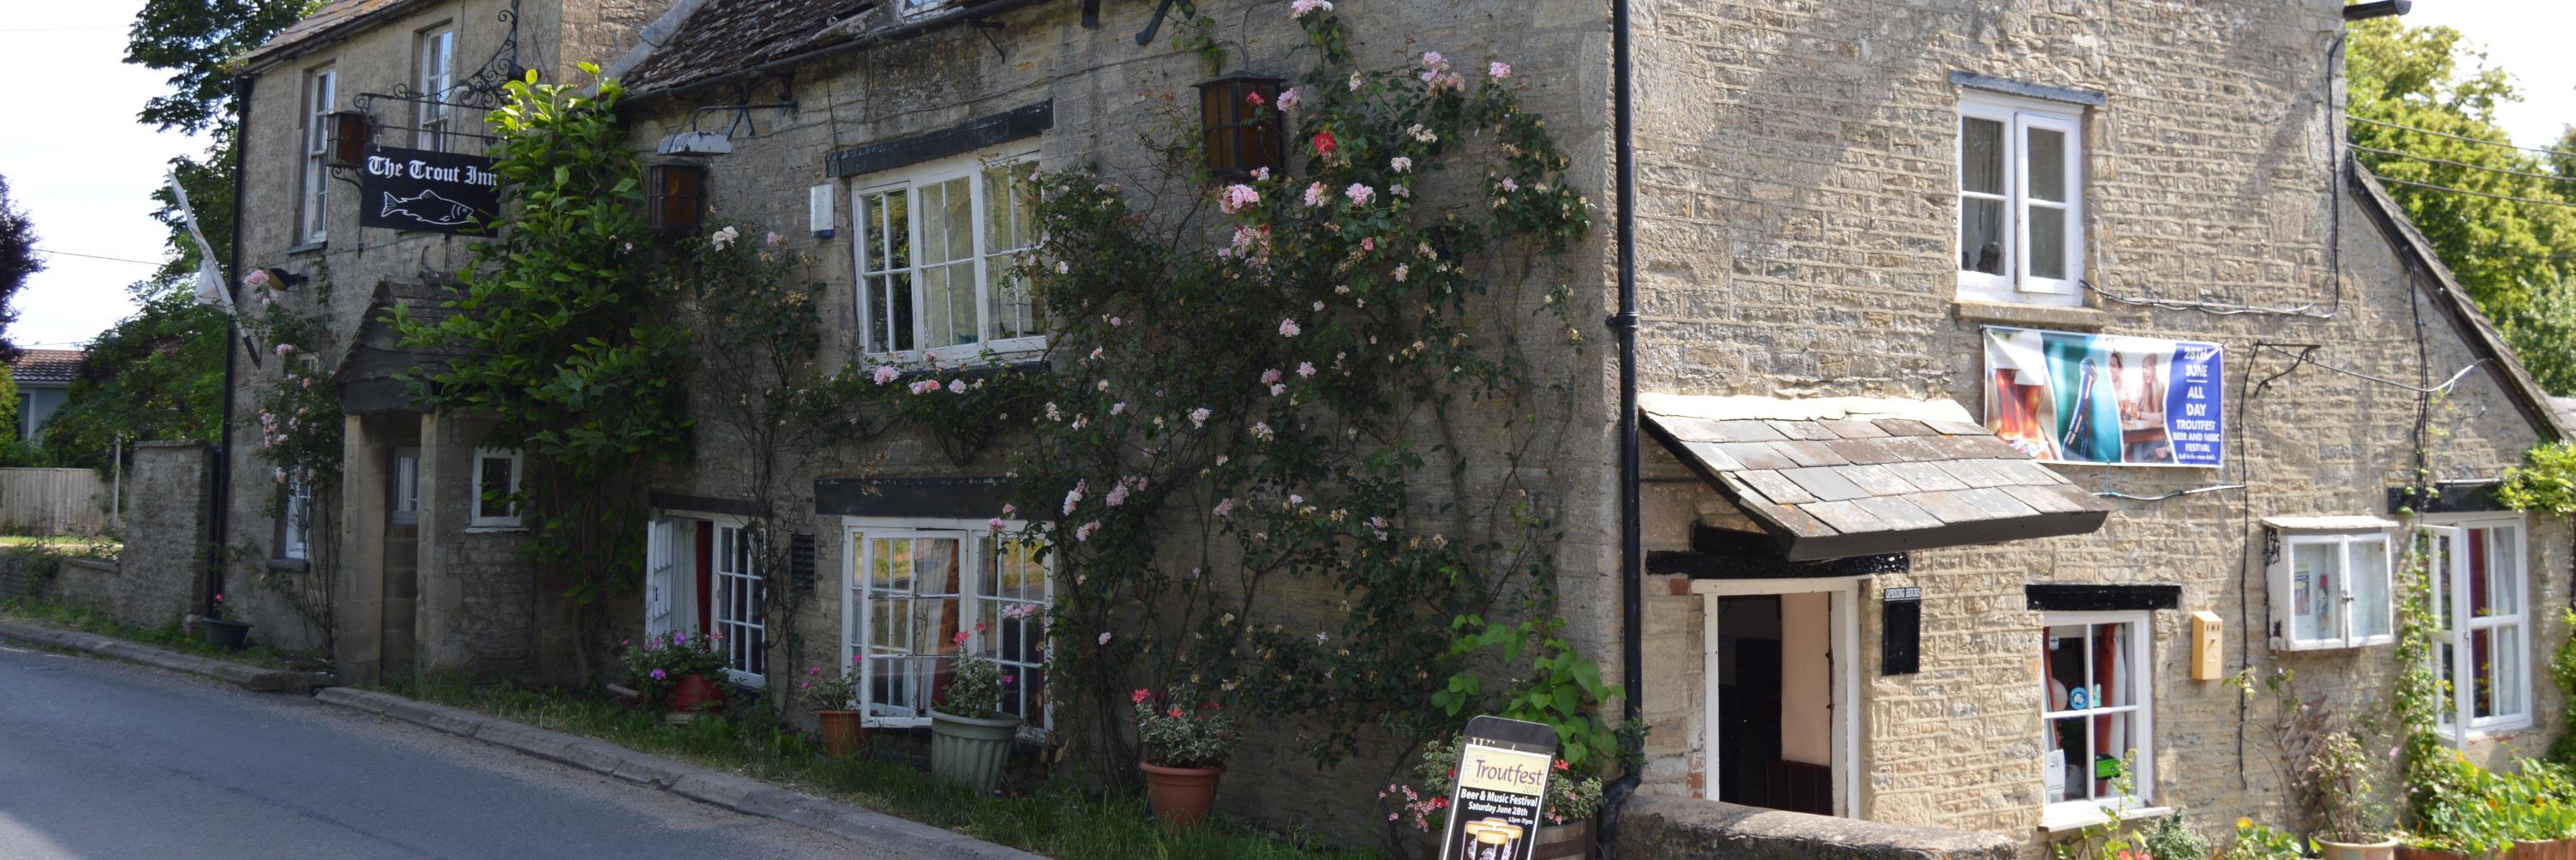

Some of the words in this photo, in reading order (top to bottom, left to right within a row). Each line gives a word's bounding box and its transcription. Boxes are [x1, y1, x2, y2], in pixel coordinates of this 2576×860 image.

[368, 155, 403, 178] The
[409, 159, 459, 183] Trout
[464, 165, 498, 186] Inn
[2185, 364, 2208, 377] JUNE
[2187, 386, 2205, 399] ALL
[2186, 404, 2207, 416] DAY
[2176, 419, 2216, 431] TROUTFEST
[2172, 432, 2188, 441] BEER
[2188, 433, 2203, 442] AND
[1885, 588, 1905, 598] OPENING
[1905, 587, 1920, 598] HOURS
[1476, 759, 1543, 786] Troutfest
[1460, 788, 1479, 800] Beer
[1480, 791, 1486, 801] &
[1486, 792, 1509, 804] Music
[1509, 795, 1538, 807] Festival
[1468, 802, 1496, 815] Saturday
[1496, 804, 1512, 815] June
[1512, 807, 1528, 816] 28th
